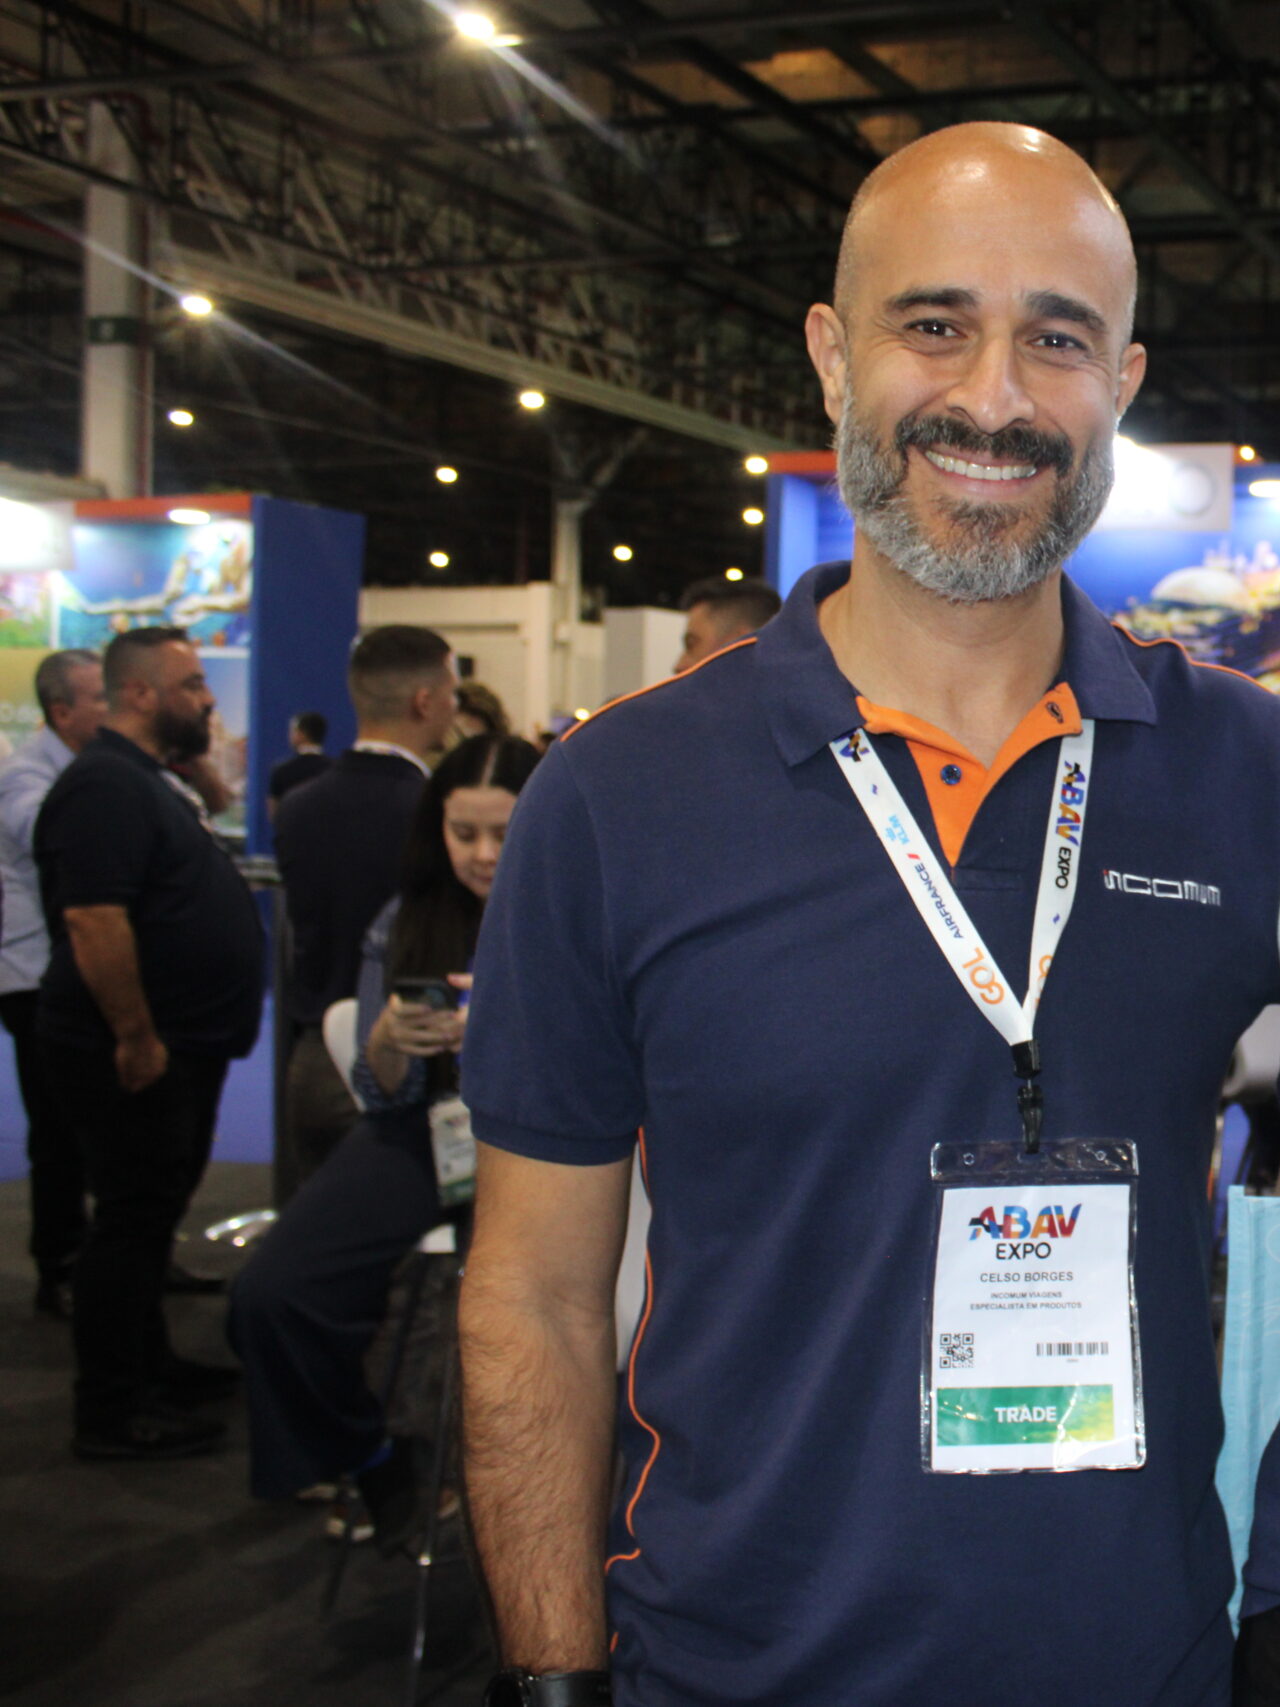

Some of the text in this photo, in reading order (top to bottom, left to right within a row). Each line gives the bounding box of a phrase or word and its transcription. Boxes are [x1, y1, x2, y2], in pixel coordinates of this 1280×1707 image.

[1055, 760, 1087, 889] ABAV EXPO
[913, 862, 964, 940] AIRFRANCE
[961, 946, 1006, 1006] GOL
[968, 1203, 1082, 1241] ABAV
[995, 1242, 1052, 1261] EXPO
[980, 1271, 1074, 1283] CELSO BORGES
[990, 1291, 1063, 1299] INCOMUM VIAGENS
[970, 1303, 1025, 1311] ESPECIALISTA
[1040, 1302, 1082, 1310] PRODUTOS
[994, 1407, 1057, 1424] TRADE
